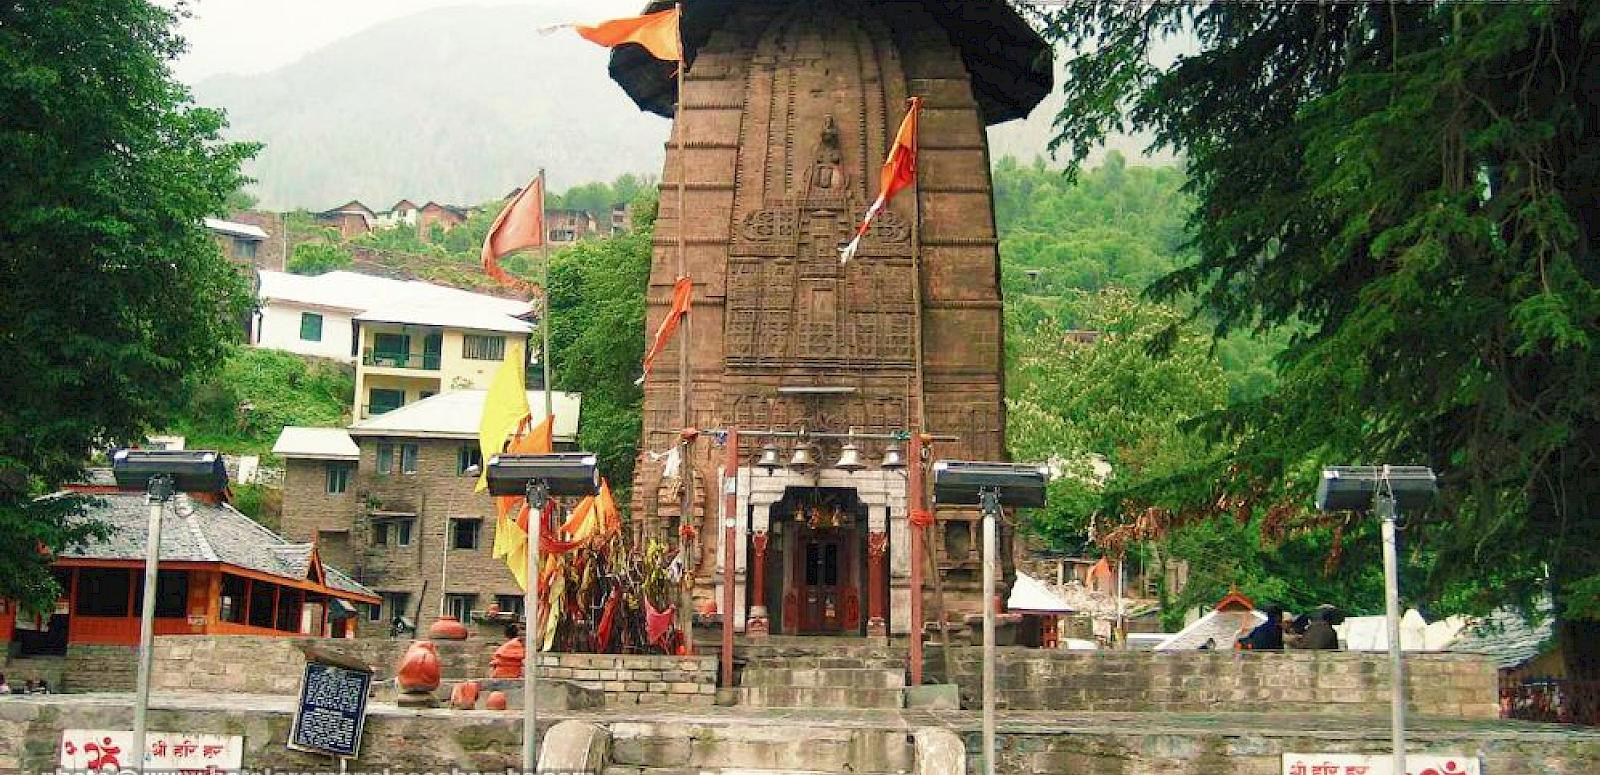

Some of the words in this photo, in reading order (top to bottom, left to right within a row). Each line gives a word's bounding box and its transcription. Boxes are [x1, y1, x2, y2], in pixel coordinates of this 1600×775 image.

[152, 739, 168, 758] श्री
[173, 740, 200, 758] हरि
[203, 744, 224, 759] हर
